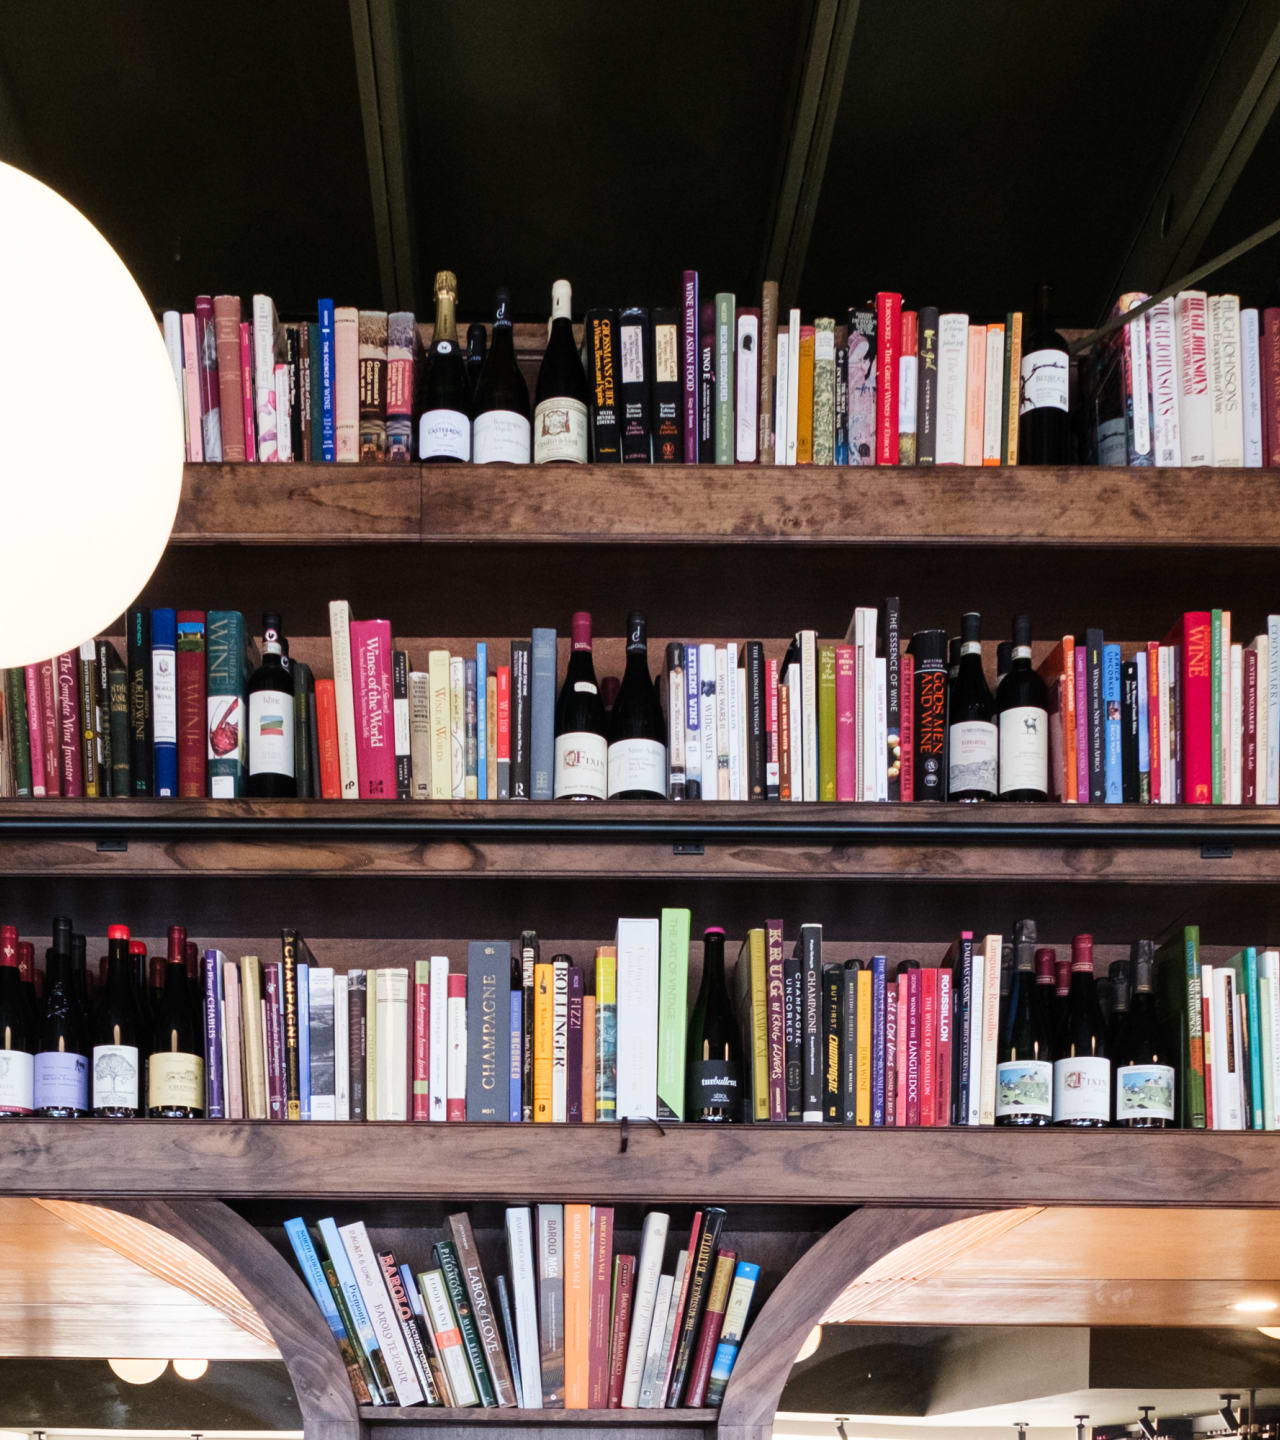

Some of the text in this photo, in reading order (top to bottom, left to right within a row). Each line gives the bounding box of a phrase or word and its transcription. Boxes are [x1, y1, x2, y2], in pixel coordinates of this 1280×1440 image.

[686, 282, 694, 306] WINE
[686, 309, 694, 333] WITH
[884, 299, 892, 342] HORNICKEL
[687, 366, 695, 391] FOOD
[884, 350, 892, 363] THE
[884, 366, 892, 389] GREAT
[883, 429, 891, 458] EUROPE
[884, 418, 891, 427] OF
[209, 618, 228, 684] WINE
[1189, 625, 1205, 678] WINE
[1269, 624, 1278, 707] COONAWARRA
[367, 638, 384, 747] Wines of the World
[688, 648, 698, 727] EXTREME WINE
[890, 675, 897, 687] OF
[59, 654, 76, 781] The Complete Wine Investor
[704, 703, 715, 761] wine wars
[920, 674, 931, 753] AND WINE
[933, 718, 943, 754] MEN
[666, 919, 678, 1020] THE ART OF VINTAGE
[769, 928, 782, 997] KRUG
[207, 997, 216, 1038] CHABLIS
[284, 946, 296, 1048] CHAMPAGNE
[554, 967, 567, 1067] BOLLINGER
[570, 998, 581, 1029] FIZZ!
[807, 971, 816, 1034] CHAMPAGNE
[910, 1018, 916, 1026] OF
[941, 975, 949, 1042] ROUSSILLON
[482, 974, 496, 1090] CHAMPAGNE
[512, 1031, 520, 1078] UNCORKED
[771, 1013, 781, 1041] KRUG
[772, 1044, 782, 1079] LOVERS
[827, 1034, 838, 1094] CHAMPAGNE
[908, 1041, 917, 1102] LANGUEDOC
[440, 1248, 463, 1301] PIEDMONT
[547, 1220, 558, 1278] BAROLO MGA
[348, 1284, 368, 1326] Piemonte
[378, 1254, 412, 1321] BAROLO
[466, 1266, 488, 1308] LABOR
[482, 1319, 499, 1353] LOVE
